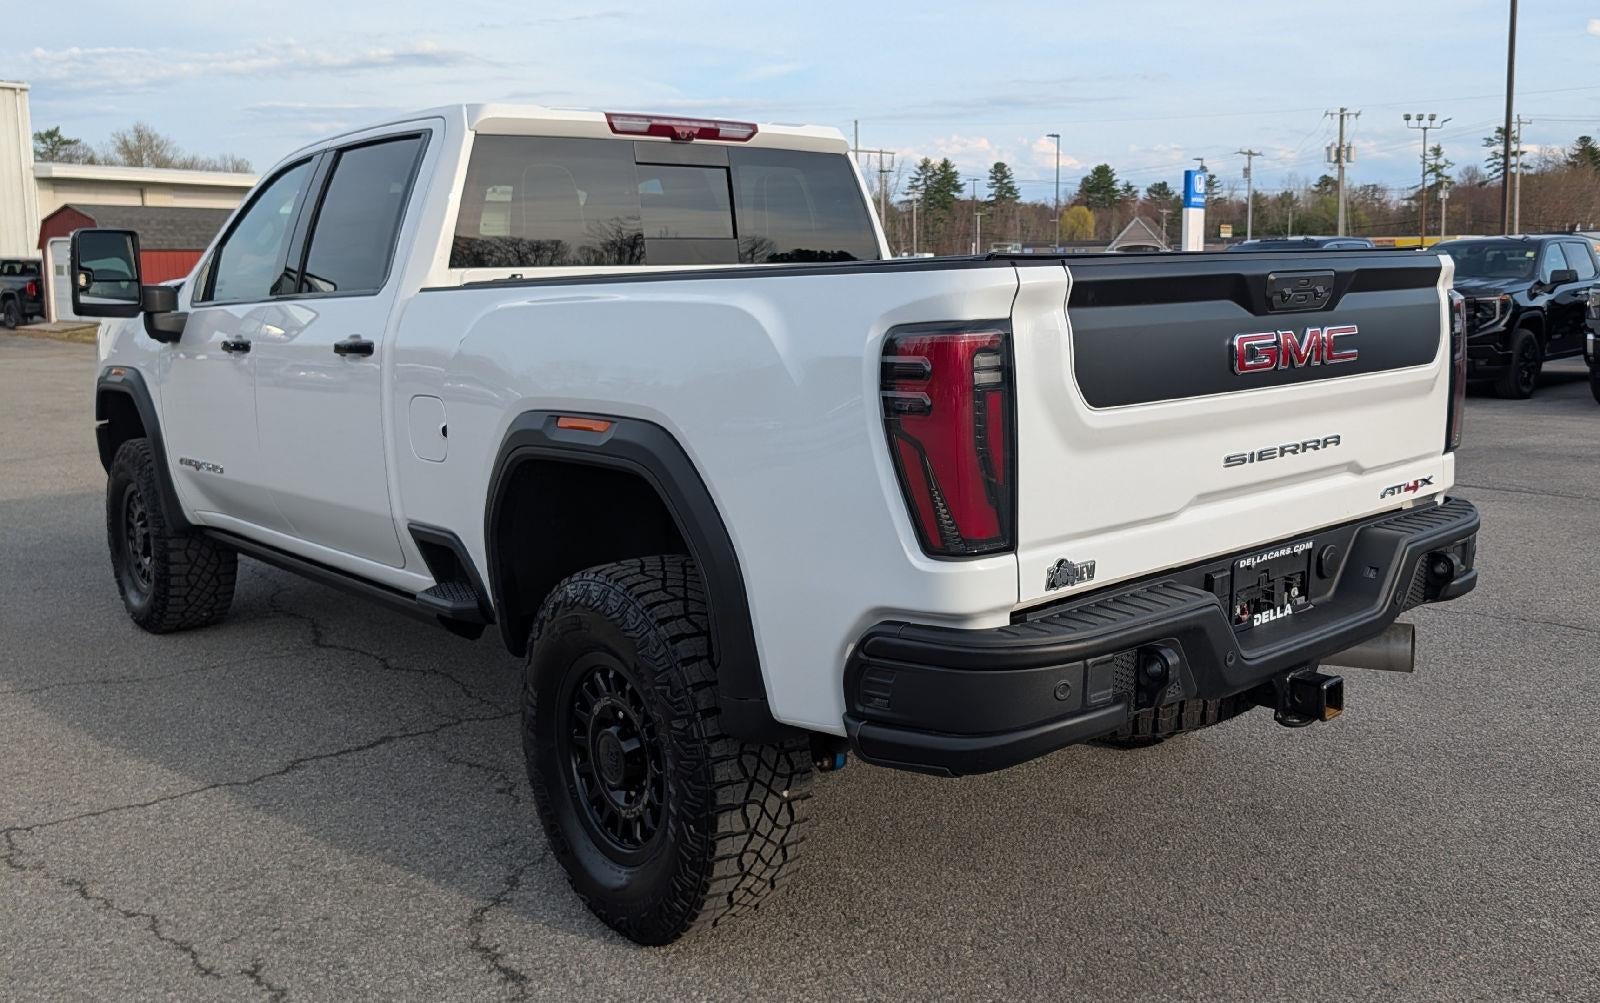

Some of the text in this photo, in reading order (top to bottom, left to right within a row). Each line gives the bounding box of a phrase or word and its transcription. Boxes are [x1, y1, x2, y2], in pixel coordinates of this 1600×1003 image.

[1233, 325, 1358, 375] GMC
[1222, 433, 1341, 468] SIERRA
[1379, 475, 1434, 499] AT4X
[1239, 541, 1313, 568] DELLACARS.COM
[1253, 603, 1293, 627] DELLA
